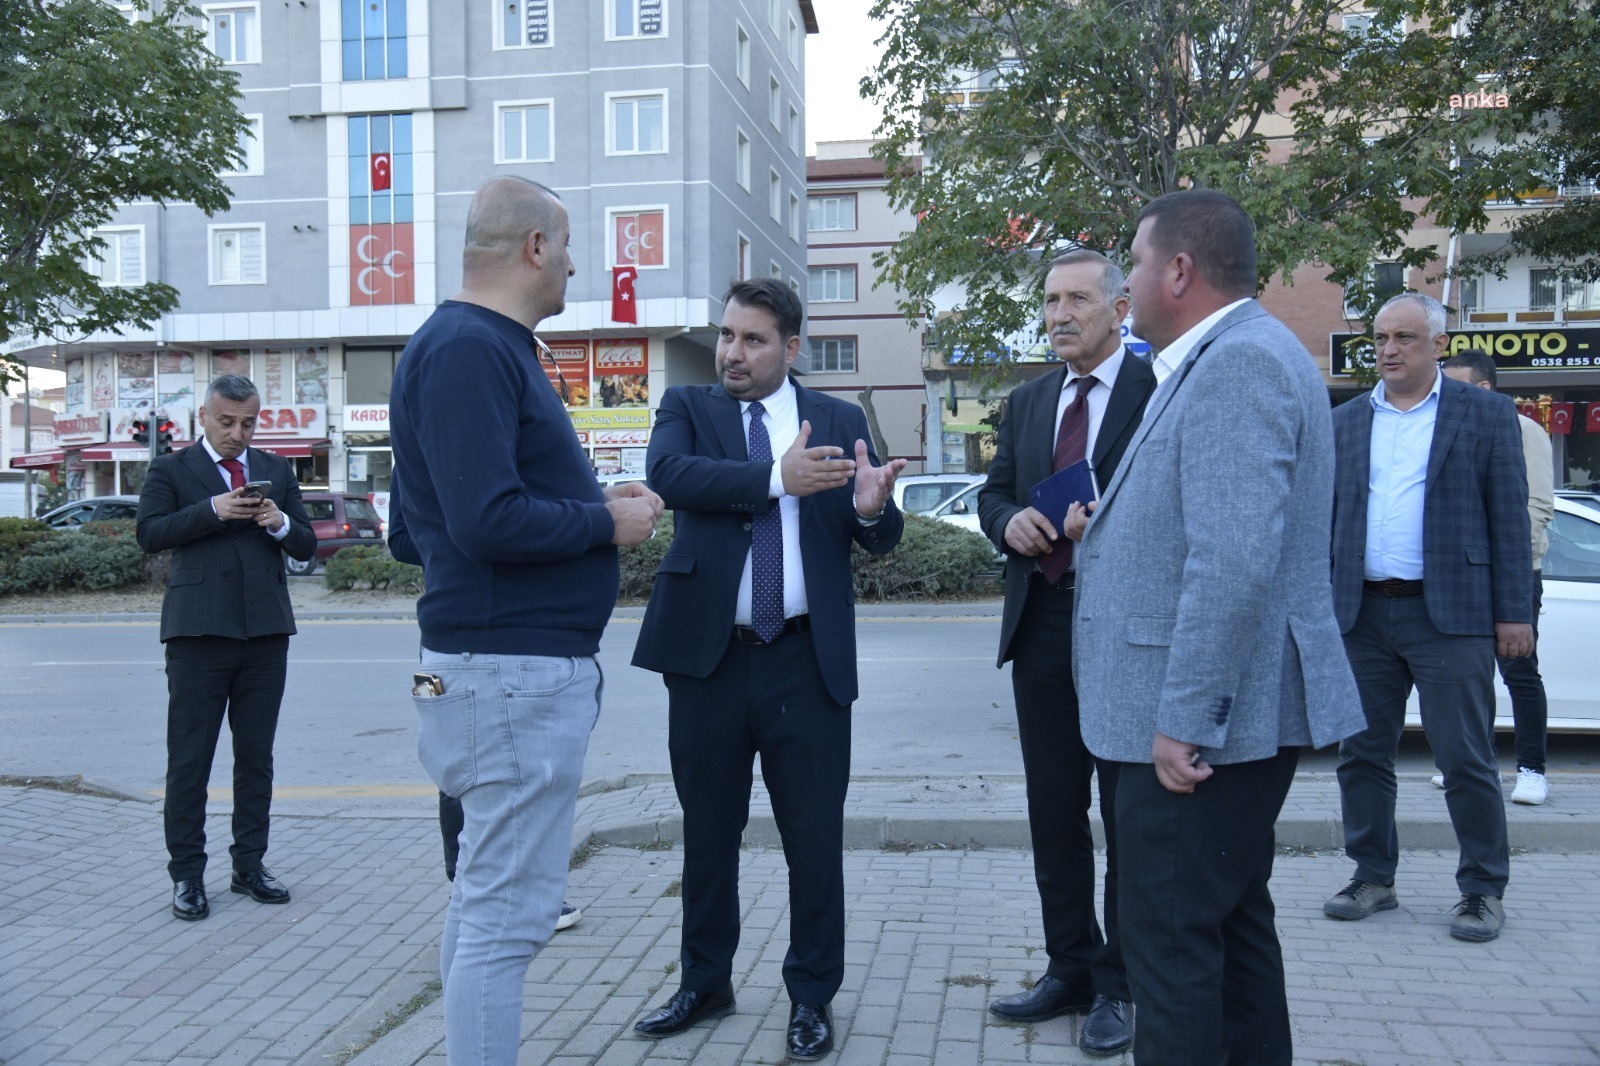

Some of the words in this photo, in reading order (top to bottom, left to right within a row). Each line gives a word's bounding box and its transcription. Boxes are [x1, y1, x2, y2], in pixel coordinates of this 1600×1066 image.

[1531, 358, 1562, 366] 0532
[1567, 357, 1590, 365] 255
[256, 408, 317, 429] SAP
[351, 409, 388, 422] KARD
